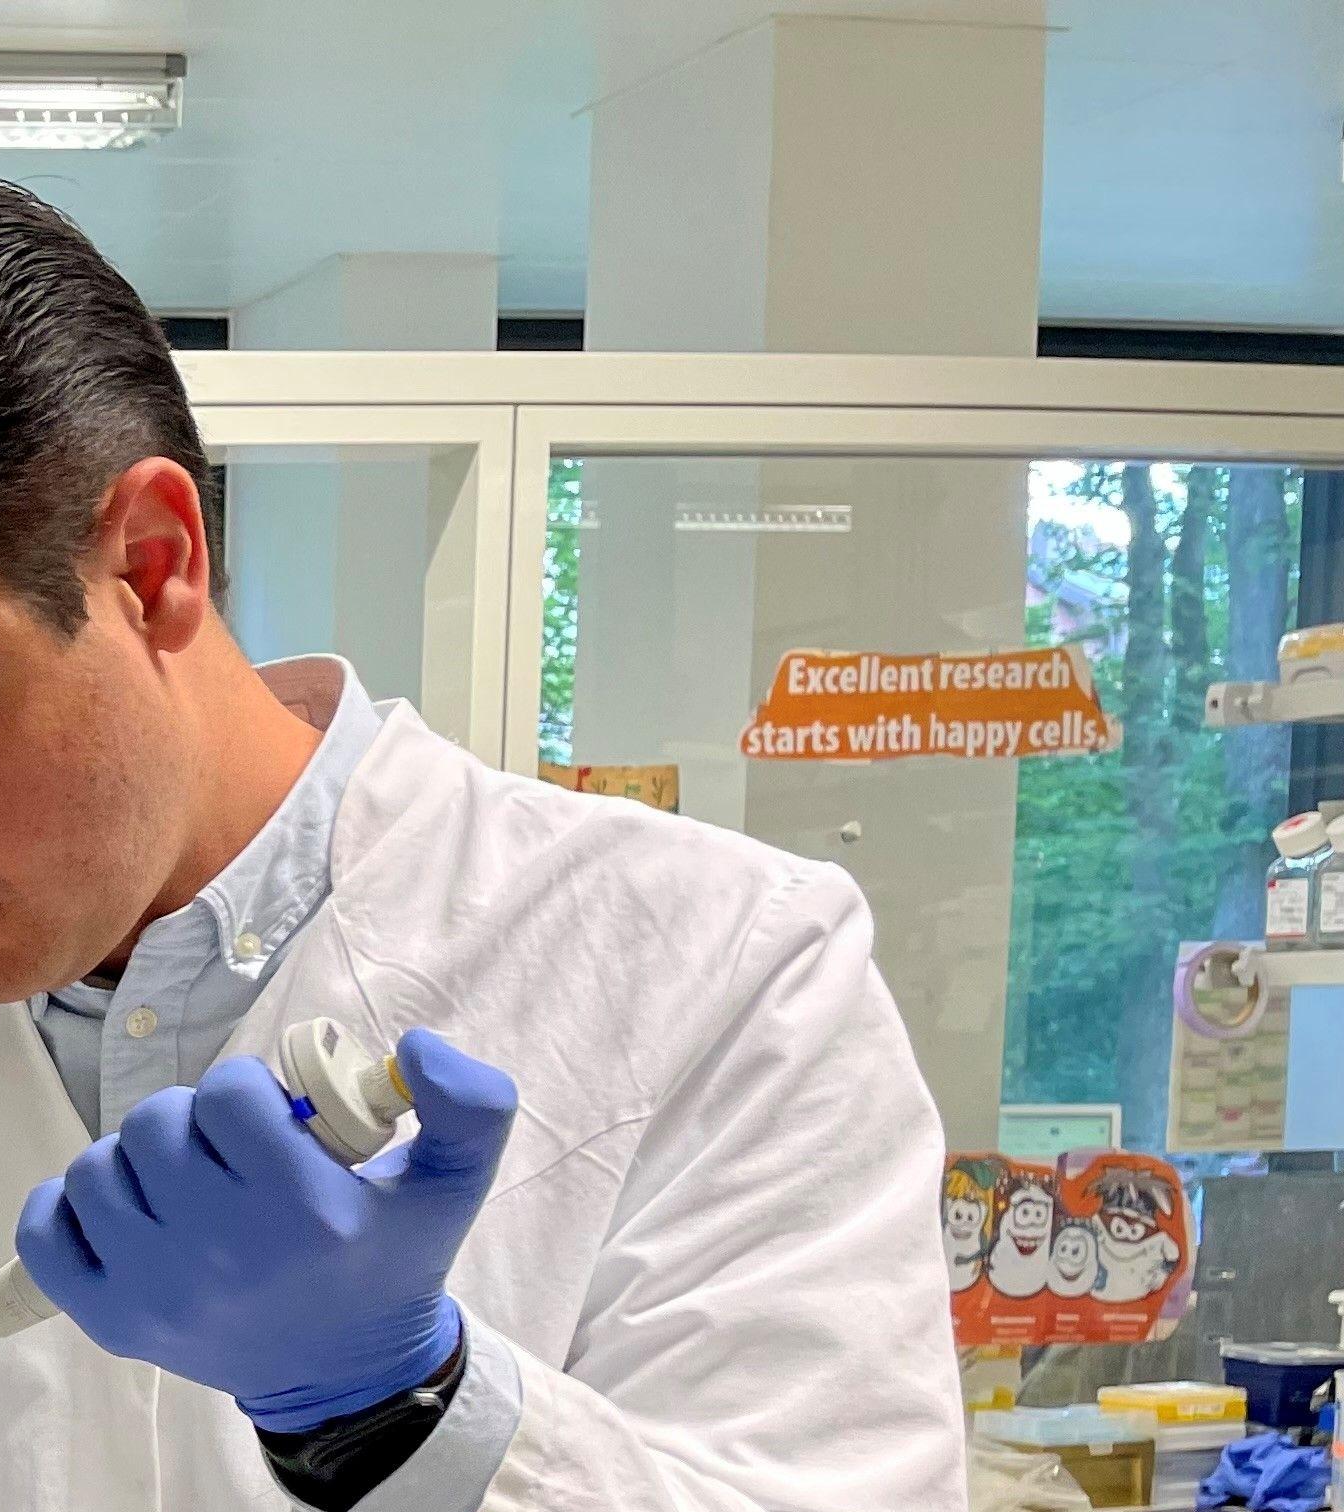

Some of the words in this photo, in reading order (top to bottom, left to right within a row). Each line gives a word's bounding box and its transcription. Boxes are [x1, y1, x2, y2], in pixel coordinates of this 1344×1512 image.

[787, 655, 934, 695] Excellent
[938, 652, 1071, 690] research
[746, 720, 840, 755] starts
[847, 713, 922, 752] with
[929, 712, 1022, 758] happy
